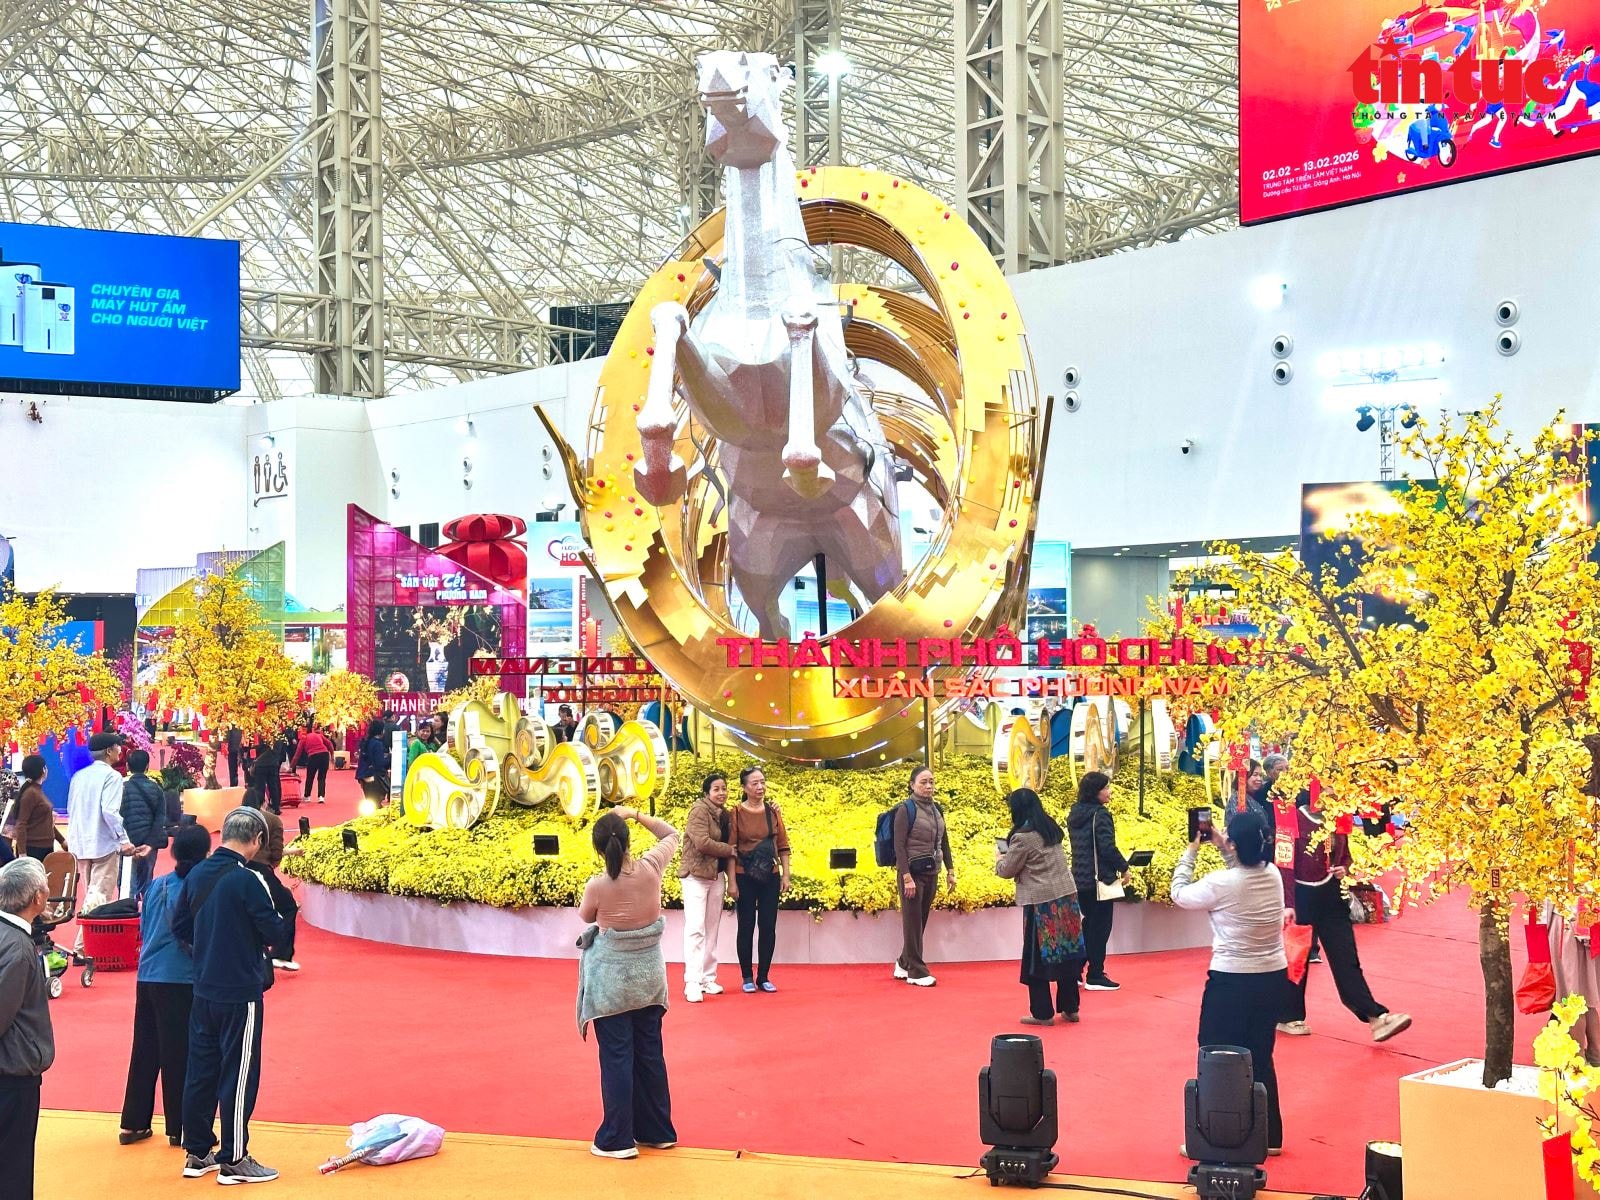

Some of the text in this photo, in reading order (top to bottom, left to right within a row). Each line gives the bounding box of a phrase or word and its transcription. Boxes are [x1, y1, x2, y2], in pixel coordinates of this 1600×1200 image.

[1263, 166, 1291, 180] 02.02
[1303, 150, 1360, 171] 13.02.2026
[1263, 180, 1282, 190] TRUNG
[1340, 164, 1353, 172] NAM
[91, 284, 180, 300] CHUYÊN GIA
[91, 297, 126, 311] MÁY
[129, 299, 159, 313] HÚT
[91, 312, 123, 325] CHO
[177, 318, 208, 331] VIỆT
[716, 631, 907, 667] THÀNH
[918, 623, 1022, 667] PHỐ
[835, 672, 934, 699] XUÂN
[383, 695, 426, 713] THÀNH
